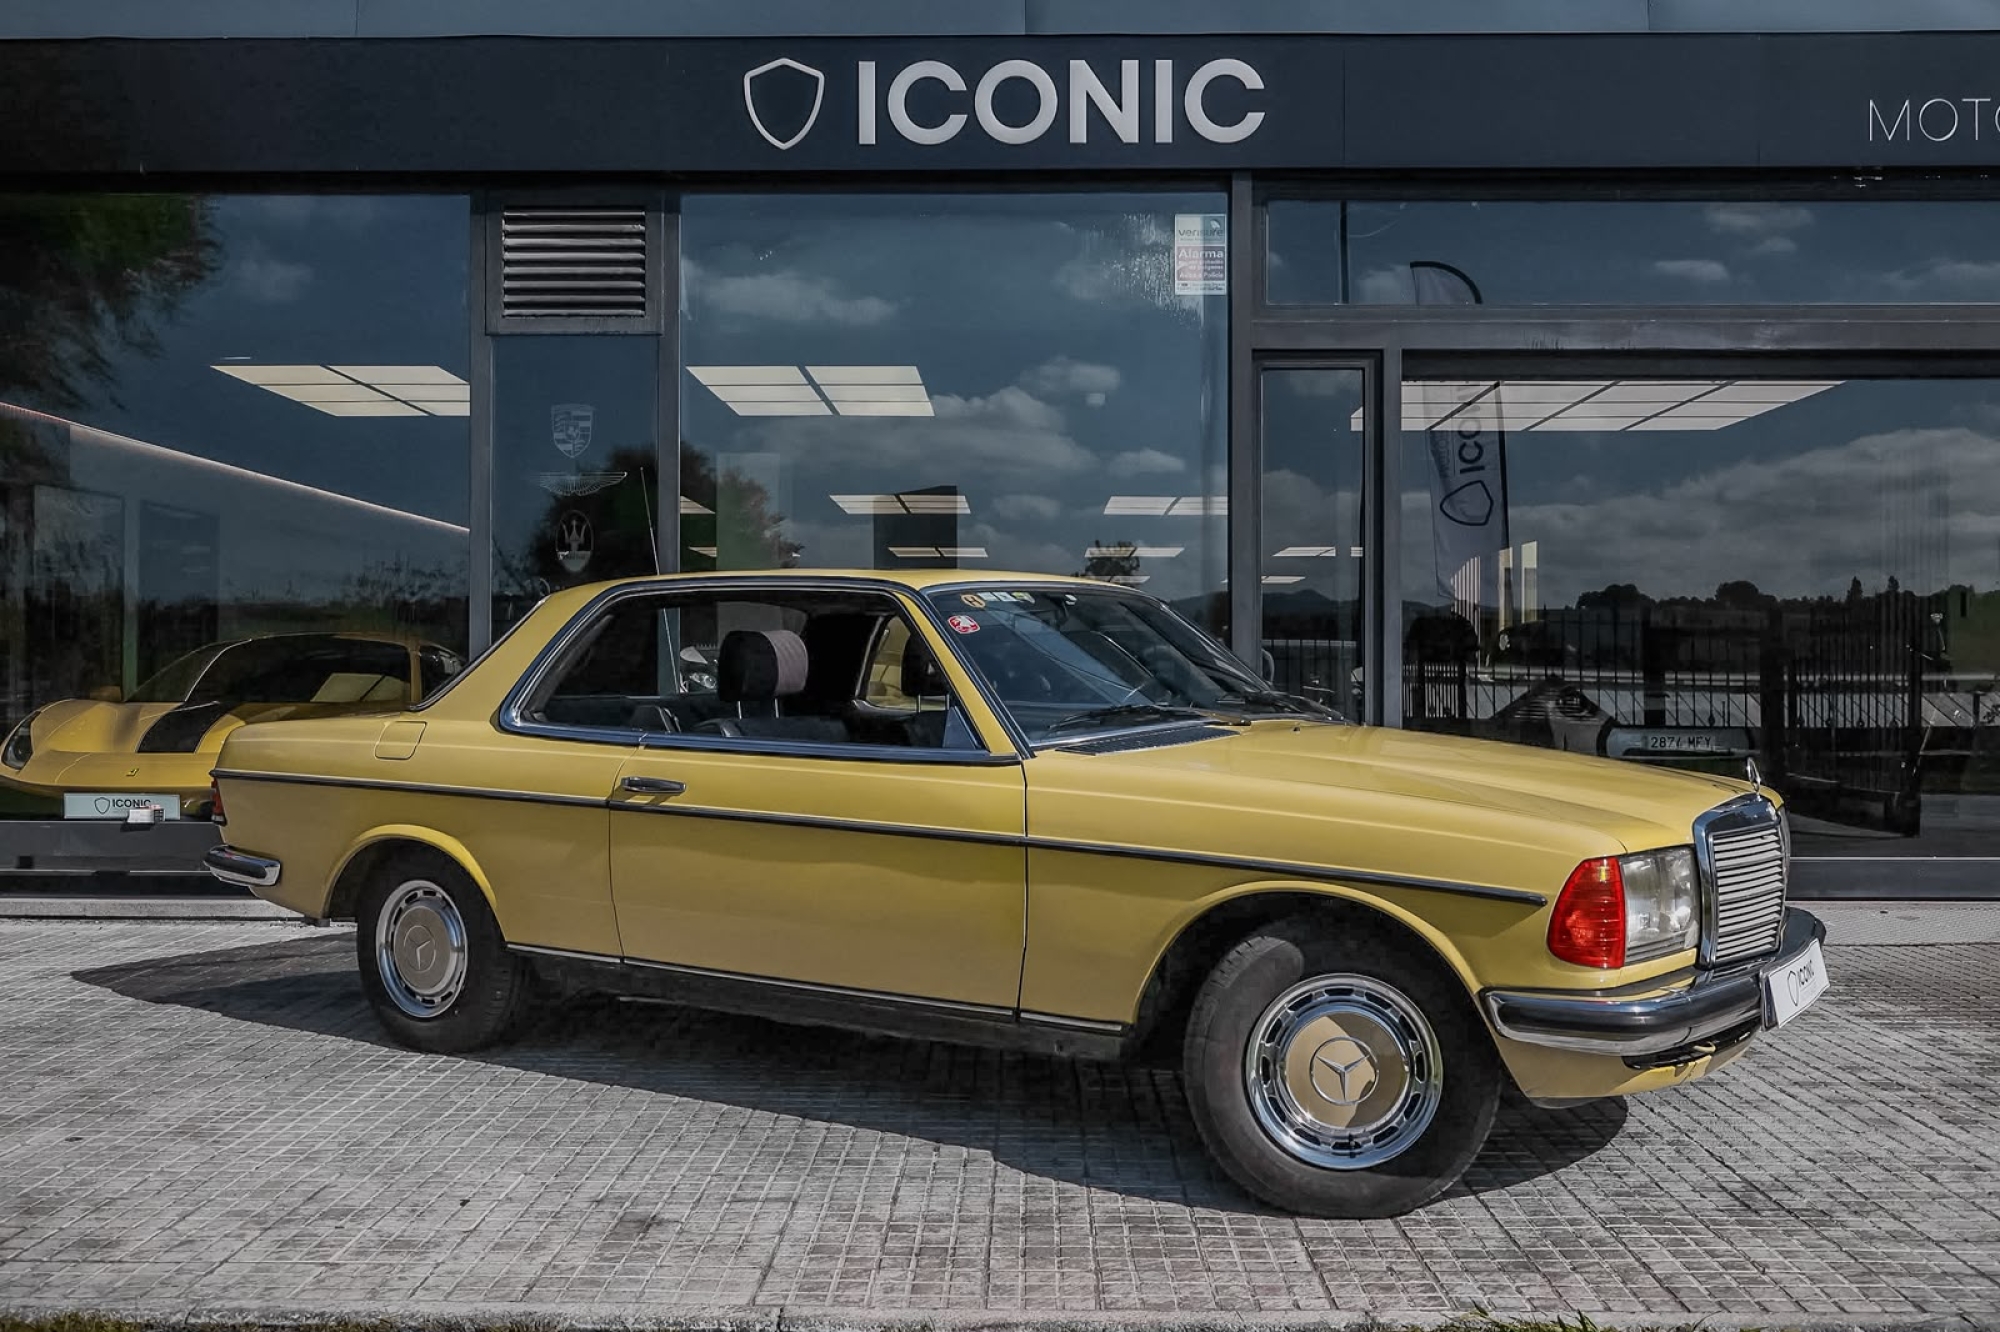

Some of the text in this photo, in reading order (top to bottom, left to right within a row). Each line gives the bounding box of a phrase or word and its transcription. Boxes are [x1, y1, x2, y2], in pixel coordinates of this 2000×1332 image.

[857, 58, 1266, 145] ICONIC
[1868, 97, 2000, 142] MOT
[1178, 228, 1224, 237] verisure
[1178, 248, 1224, 258] Alarma
[1688, 736, 1711, 748] MFY
[112, 798, 151, 808] ICONIC
